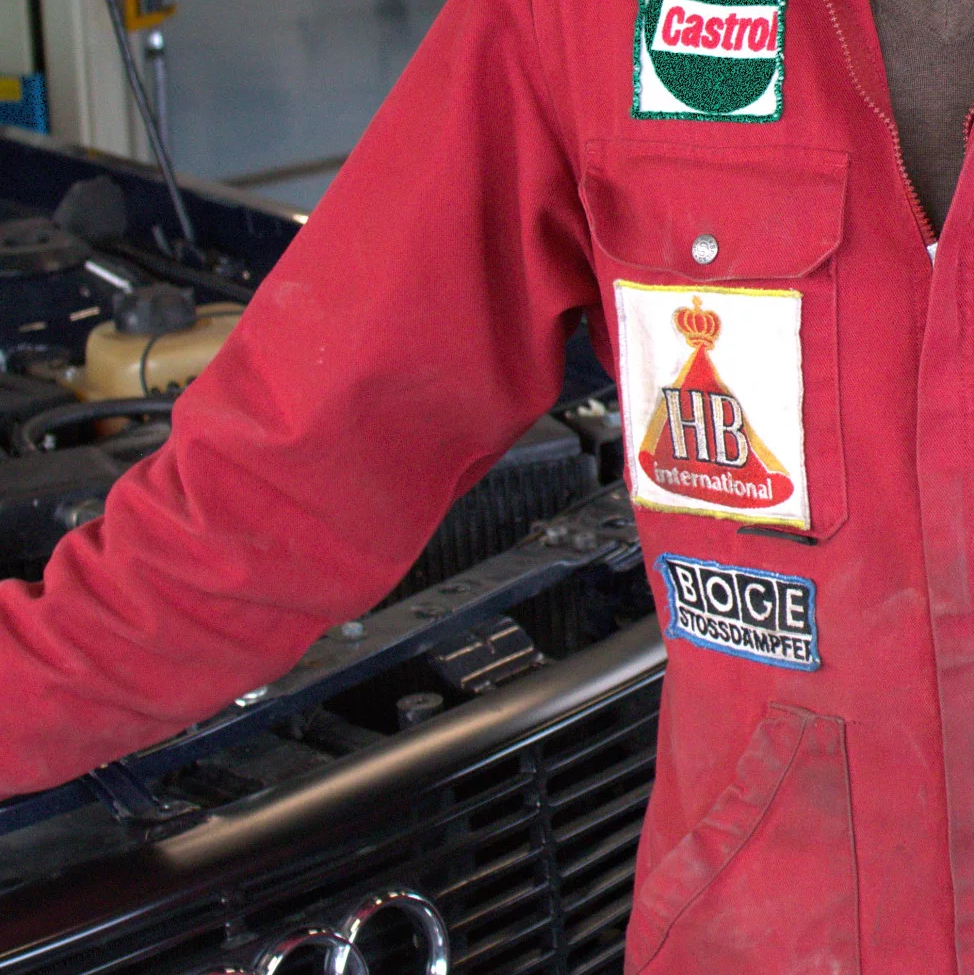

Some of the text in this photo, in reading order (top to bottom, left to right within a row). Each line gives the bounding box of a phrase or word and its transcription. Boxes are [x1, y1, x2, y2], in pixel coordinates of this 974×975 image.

[661, 5, 778, 52] Castrol
[662, 387, 748, 469] HB
[653, 462, 773, 500] international
[675, 566, 805, 628] BOGE
